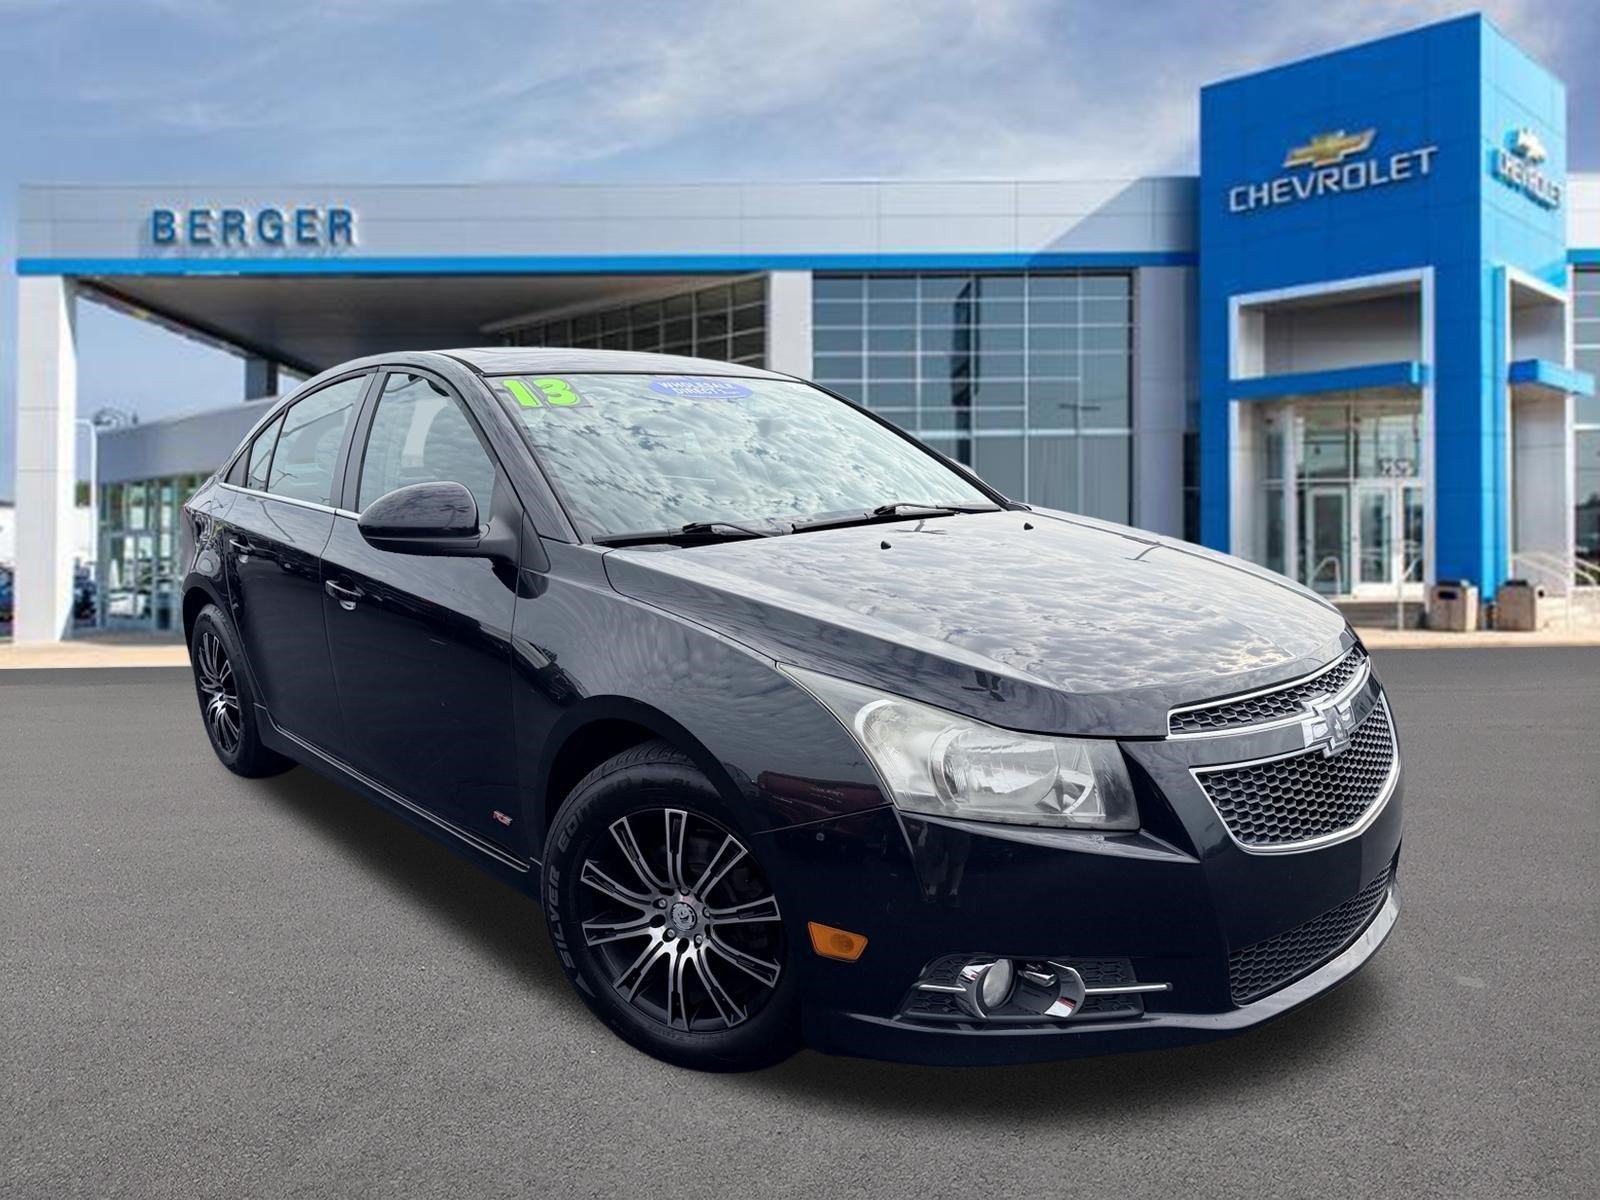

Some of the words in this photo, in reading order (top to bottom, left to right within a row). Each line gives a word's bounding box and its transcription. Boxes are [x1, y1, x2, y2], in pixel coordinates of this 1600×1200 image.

[1228, 146, 1438, 214] CHEVROLET
[151, 208, 356, 245] BERGER
[503, 377, 579, 408] 13
[549, 865, 576, 969] SILVER
